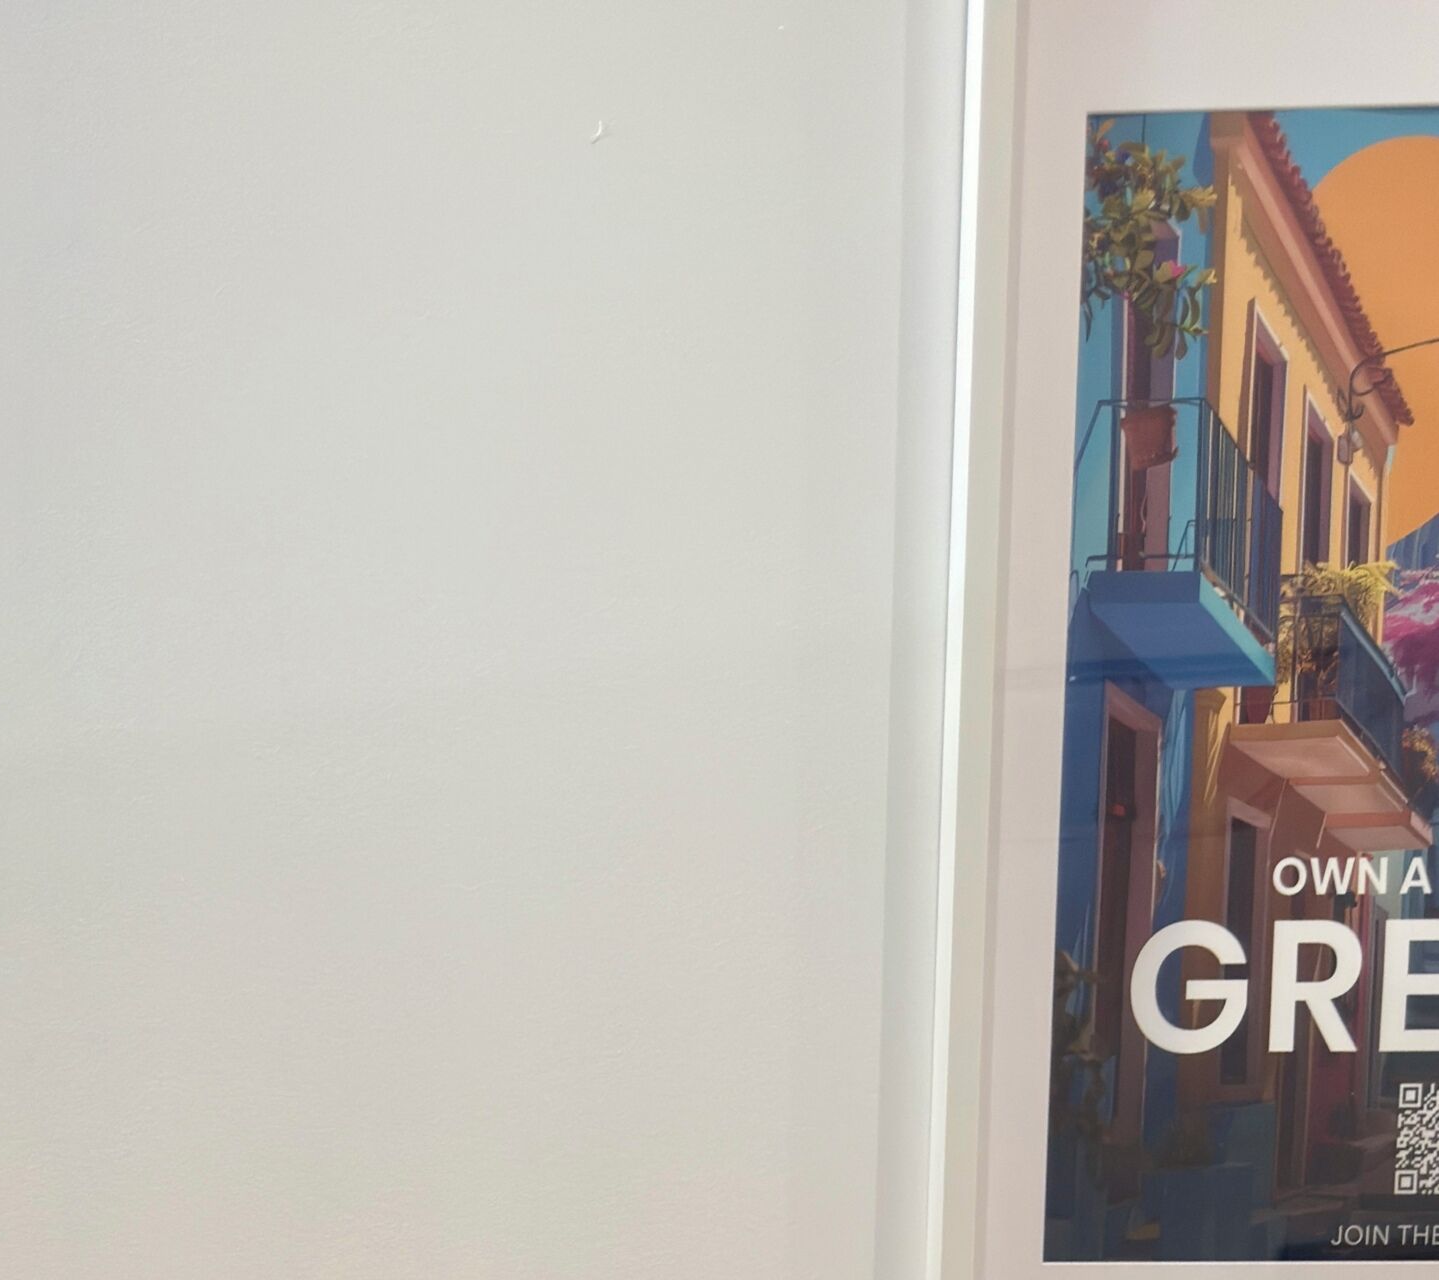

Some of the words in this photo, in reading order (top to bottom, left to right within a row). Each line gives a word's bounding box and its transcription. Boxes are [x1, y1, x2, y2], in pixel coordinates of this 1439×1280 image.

[1272, 857, 1388, 895] OWN
[1400, 857, 1433, 895] A
[1130, 919, 1439, 1054] GRE
[1330, 1225, 1390, 1246] JOIN
